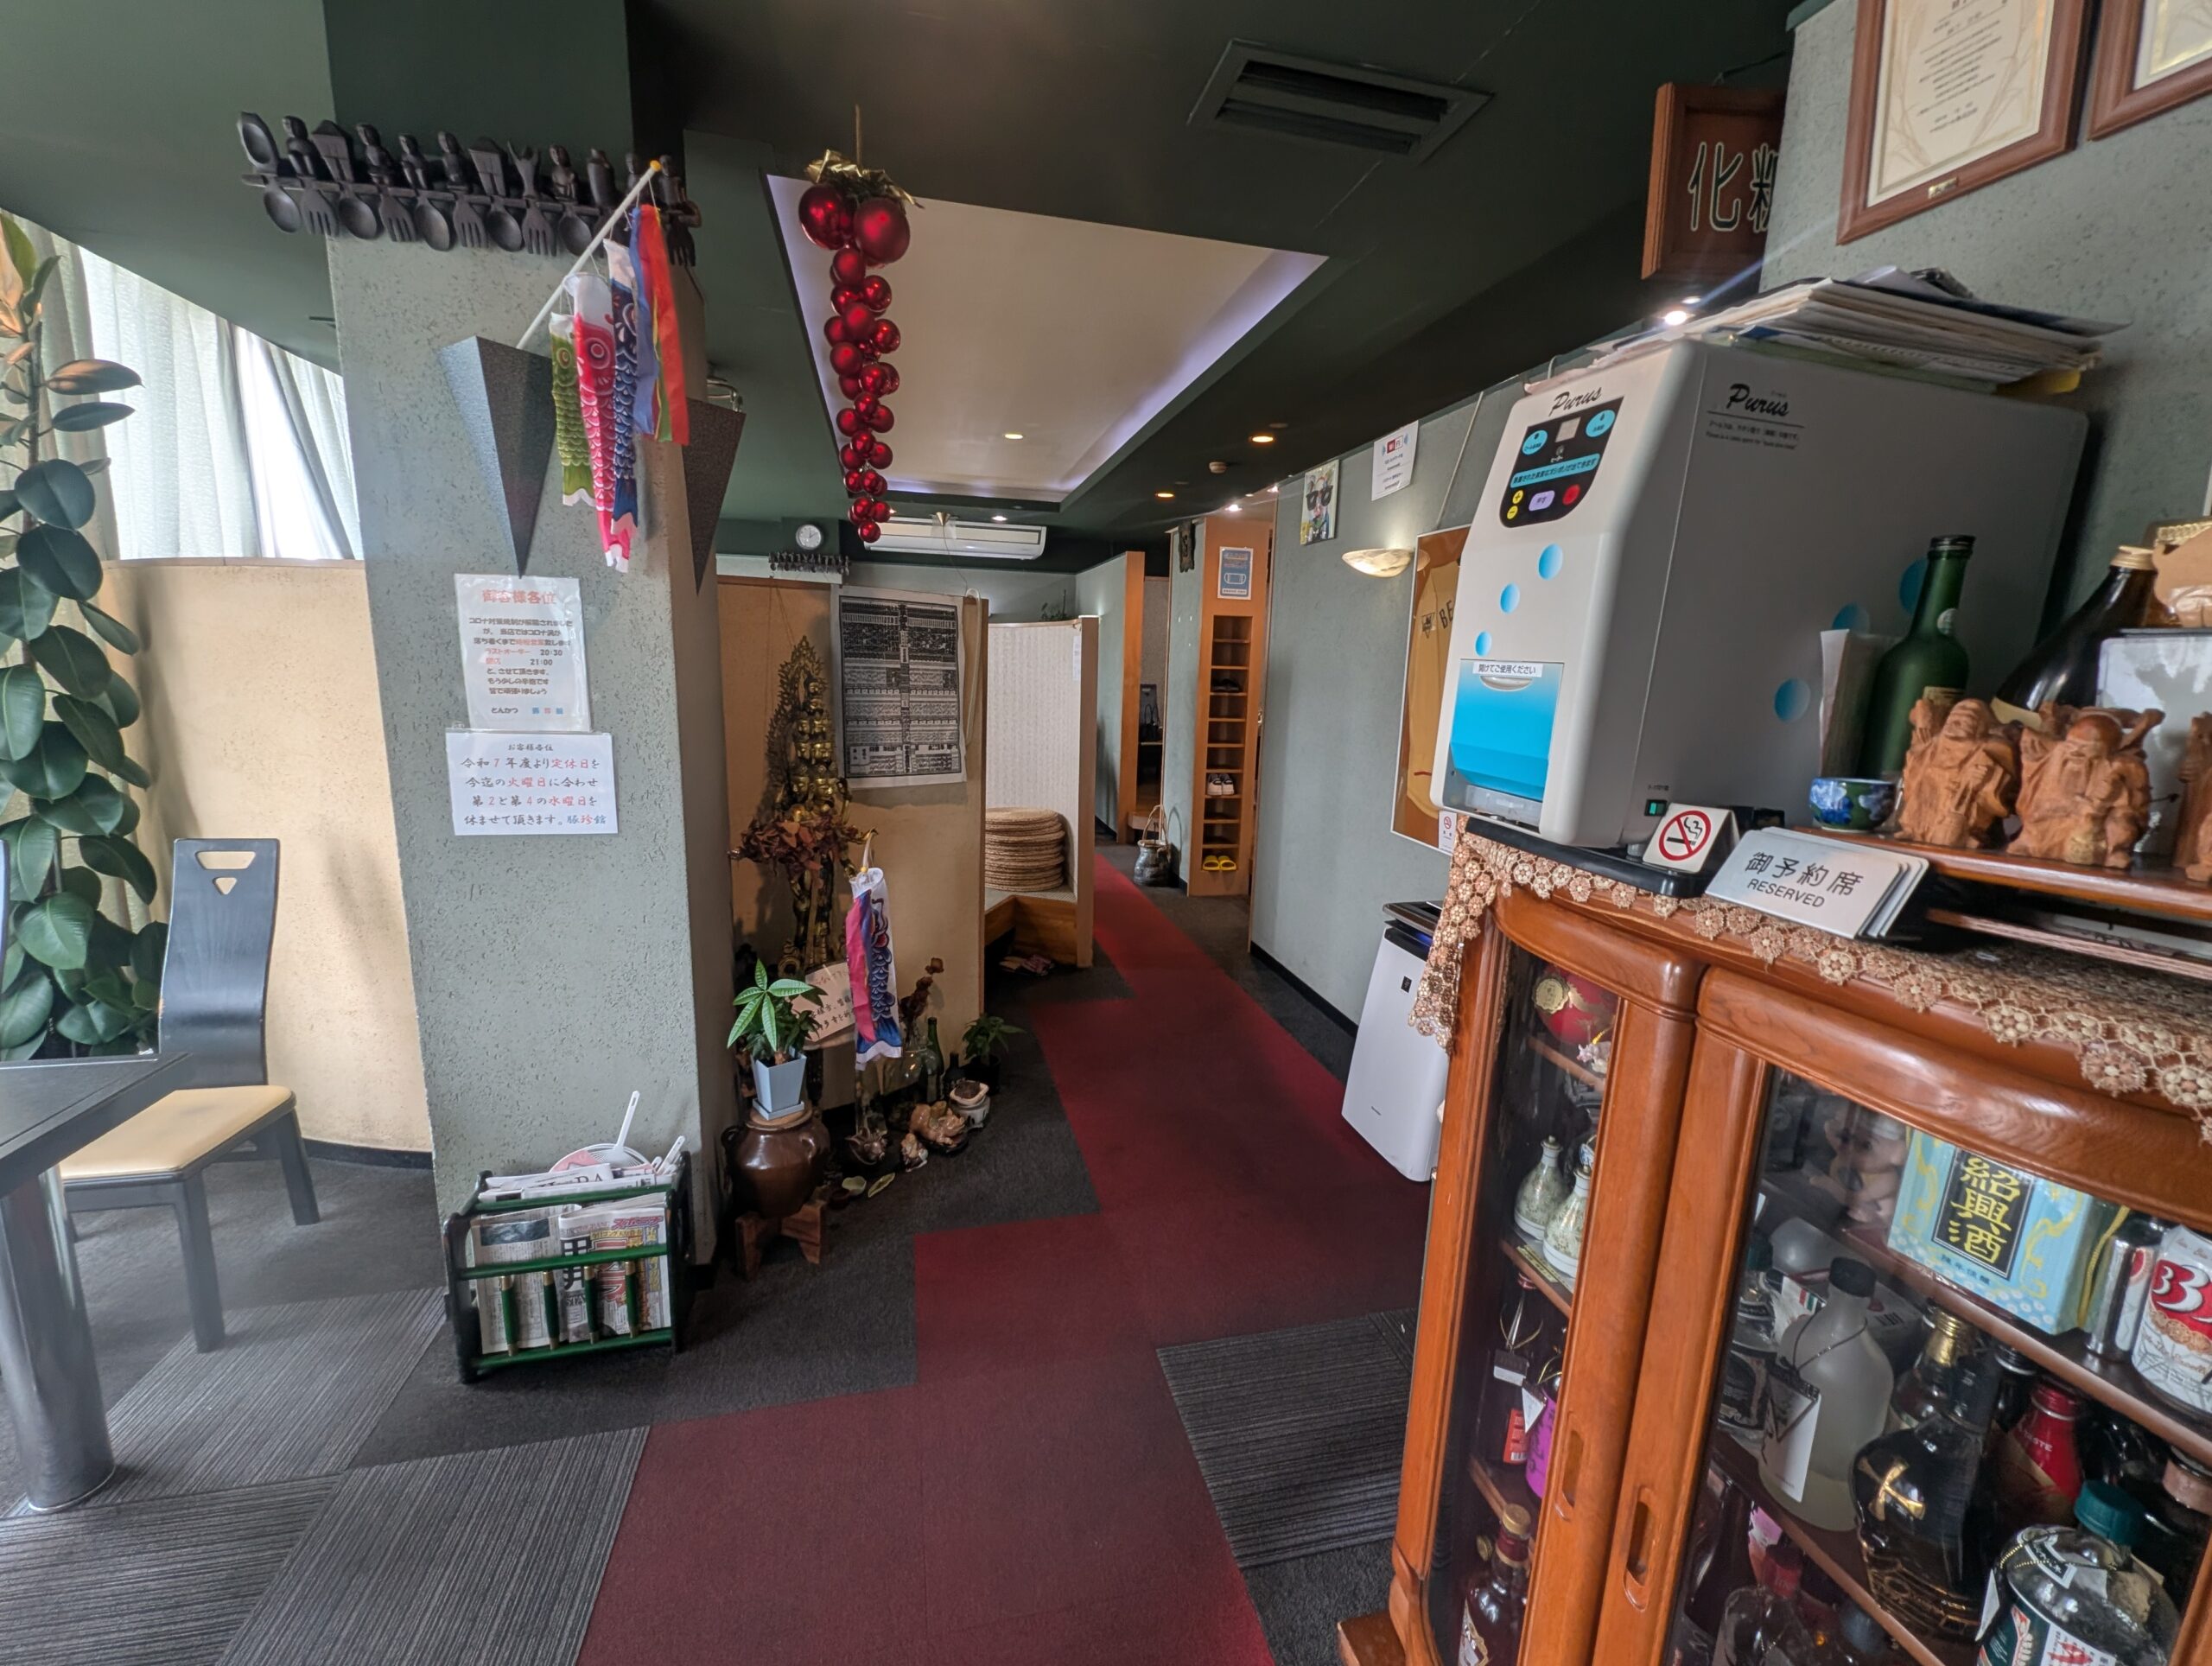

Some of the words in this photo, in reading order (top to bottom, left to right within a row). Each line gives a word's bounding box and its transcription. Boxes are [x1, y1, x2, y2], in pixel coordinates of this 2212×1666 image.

[1548, 387, 1602, 416] Purus
[1726, 383, 1789, 416] Purus
[1745, 851, 1864, 895] 御予約席
[1746, 878, 1825, 908] RESERVED
[1948, 1156, 2021, 1264] 紹興酒
